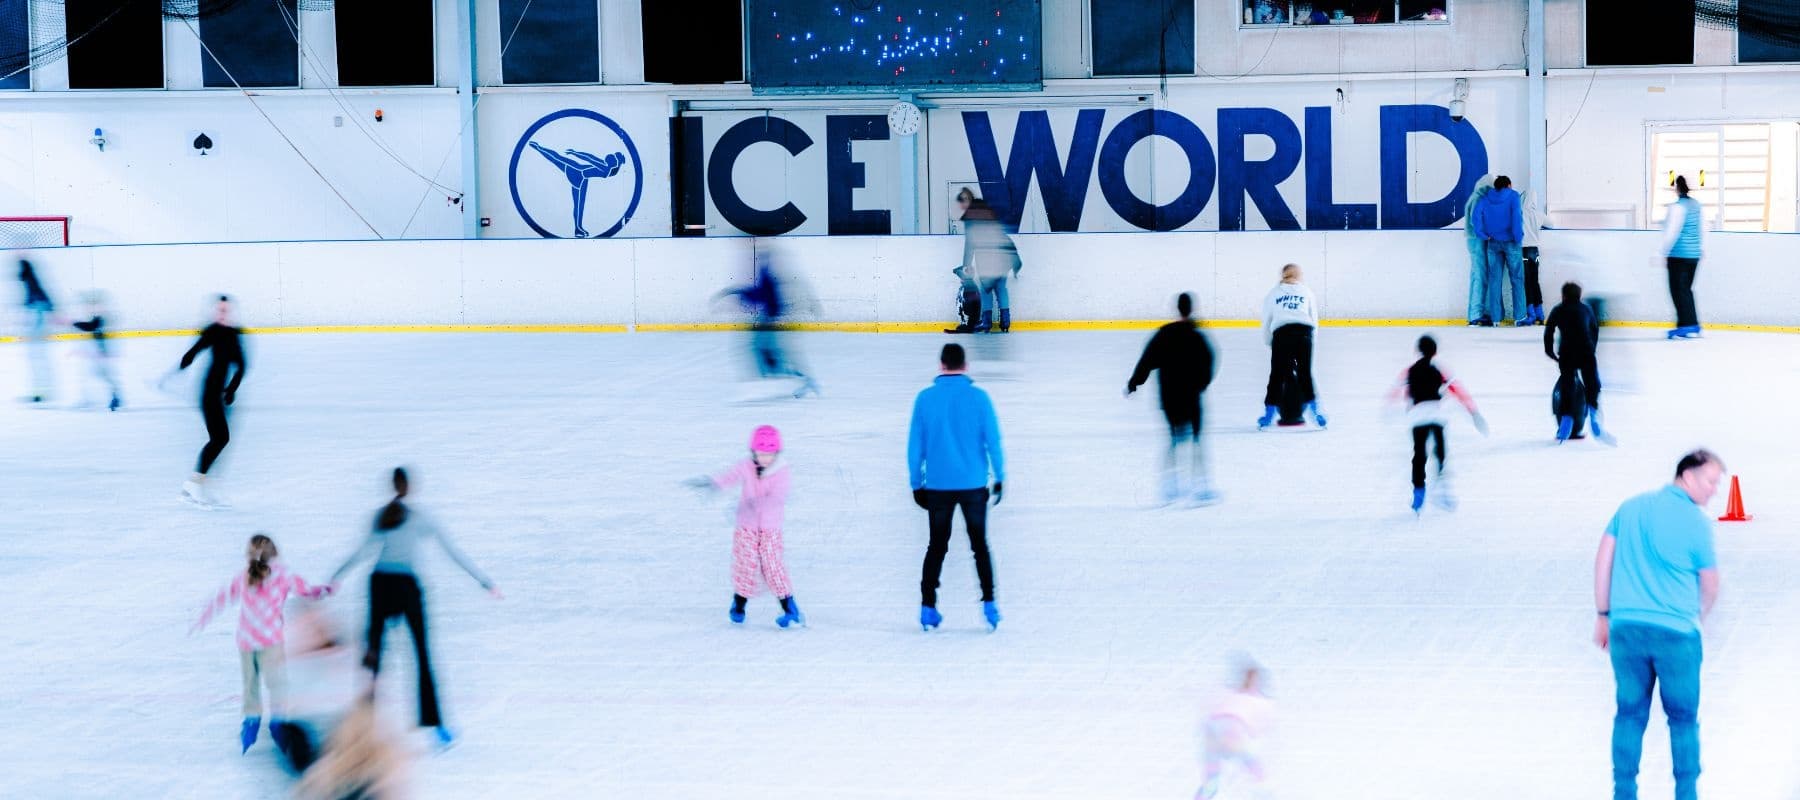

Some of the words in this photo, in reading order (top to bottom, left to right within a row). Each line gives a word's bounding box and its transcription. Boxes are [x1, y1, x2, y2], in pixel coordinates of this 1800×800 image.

[669, 115, 891, 237] ICE
[961, 104, 1488, 232] WORLD
[1275, 295, 1305, 304] WHITE
